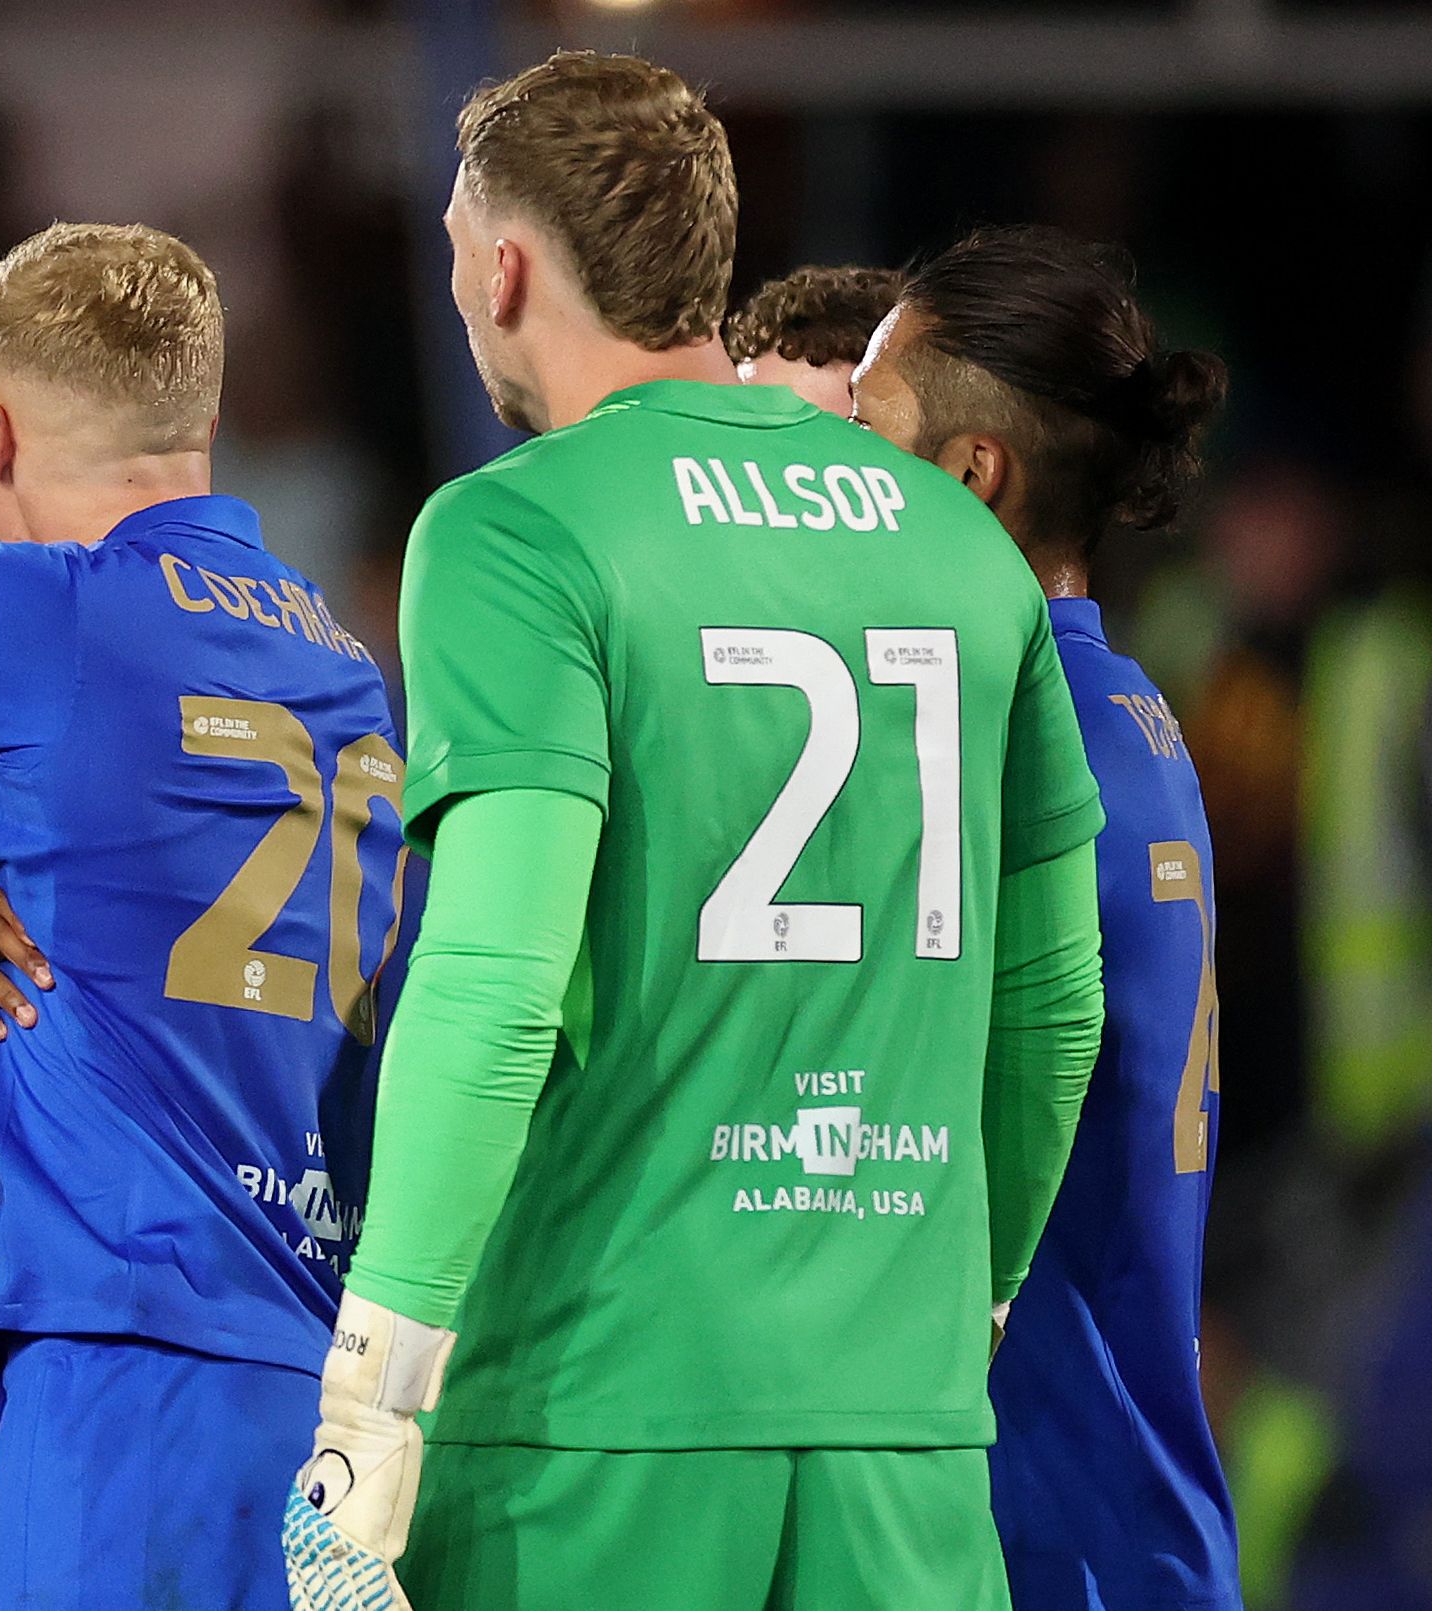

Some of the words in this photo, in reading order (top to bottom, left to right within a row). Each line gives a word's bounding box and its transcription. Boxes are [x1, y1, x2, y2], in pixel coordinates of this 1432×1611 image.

[672, 457, 906, 531] ALLSOP
[697, 626, 962, 963] 21
[164, 695, 410, 1047] 20
[244, 987, 262, 1001] EFL
[795, 1070, 865, 1096] VISIT
[710, 1123, 949, 1164] BIRMINGHAM
[733, 1186, 864, 1220] ALABAMA,
[872, 1190, 925, 1216] USA
